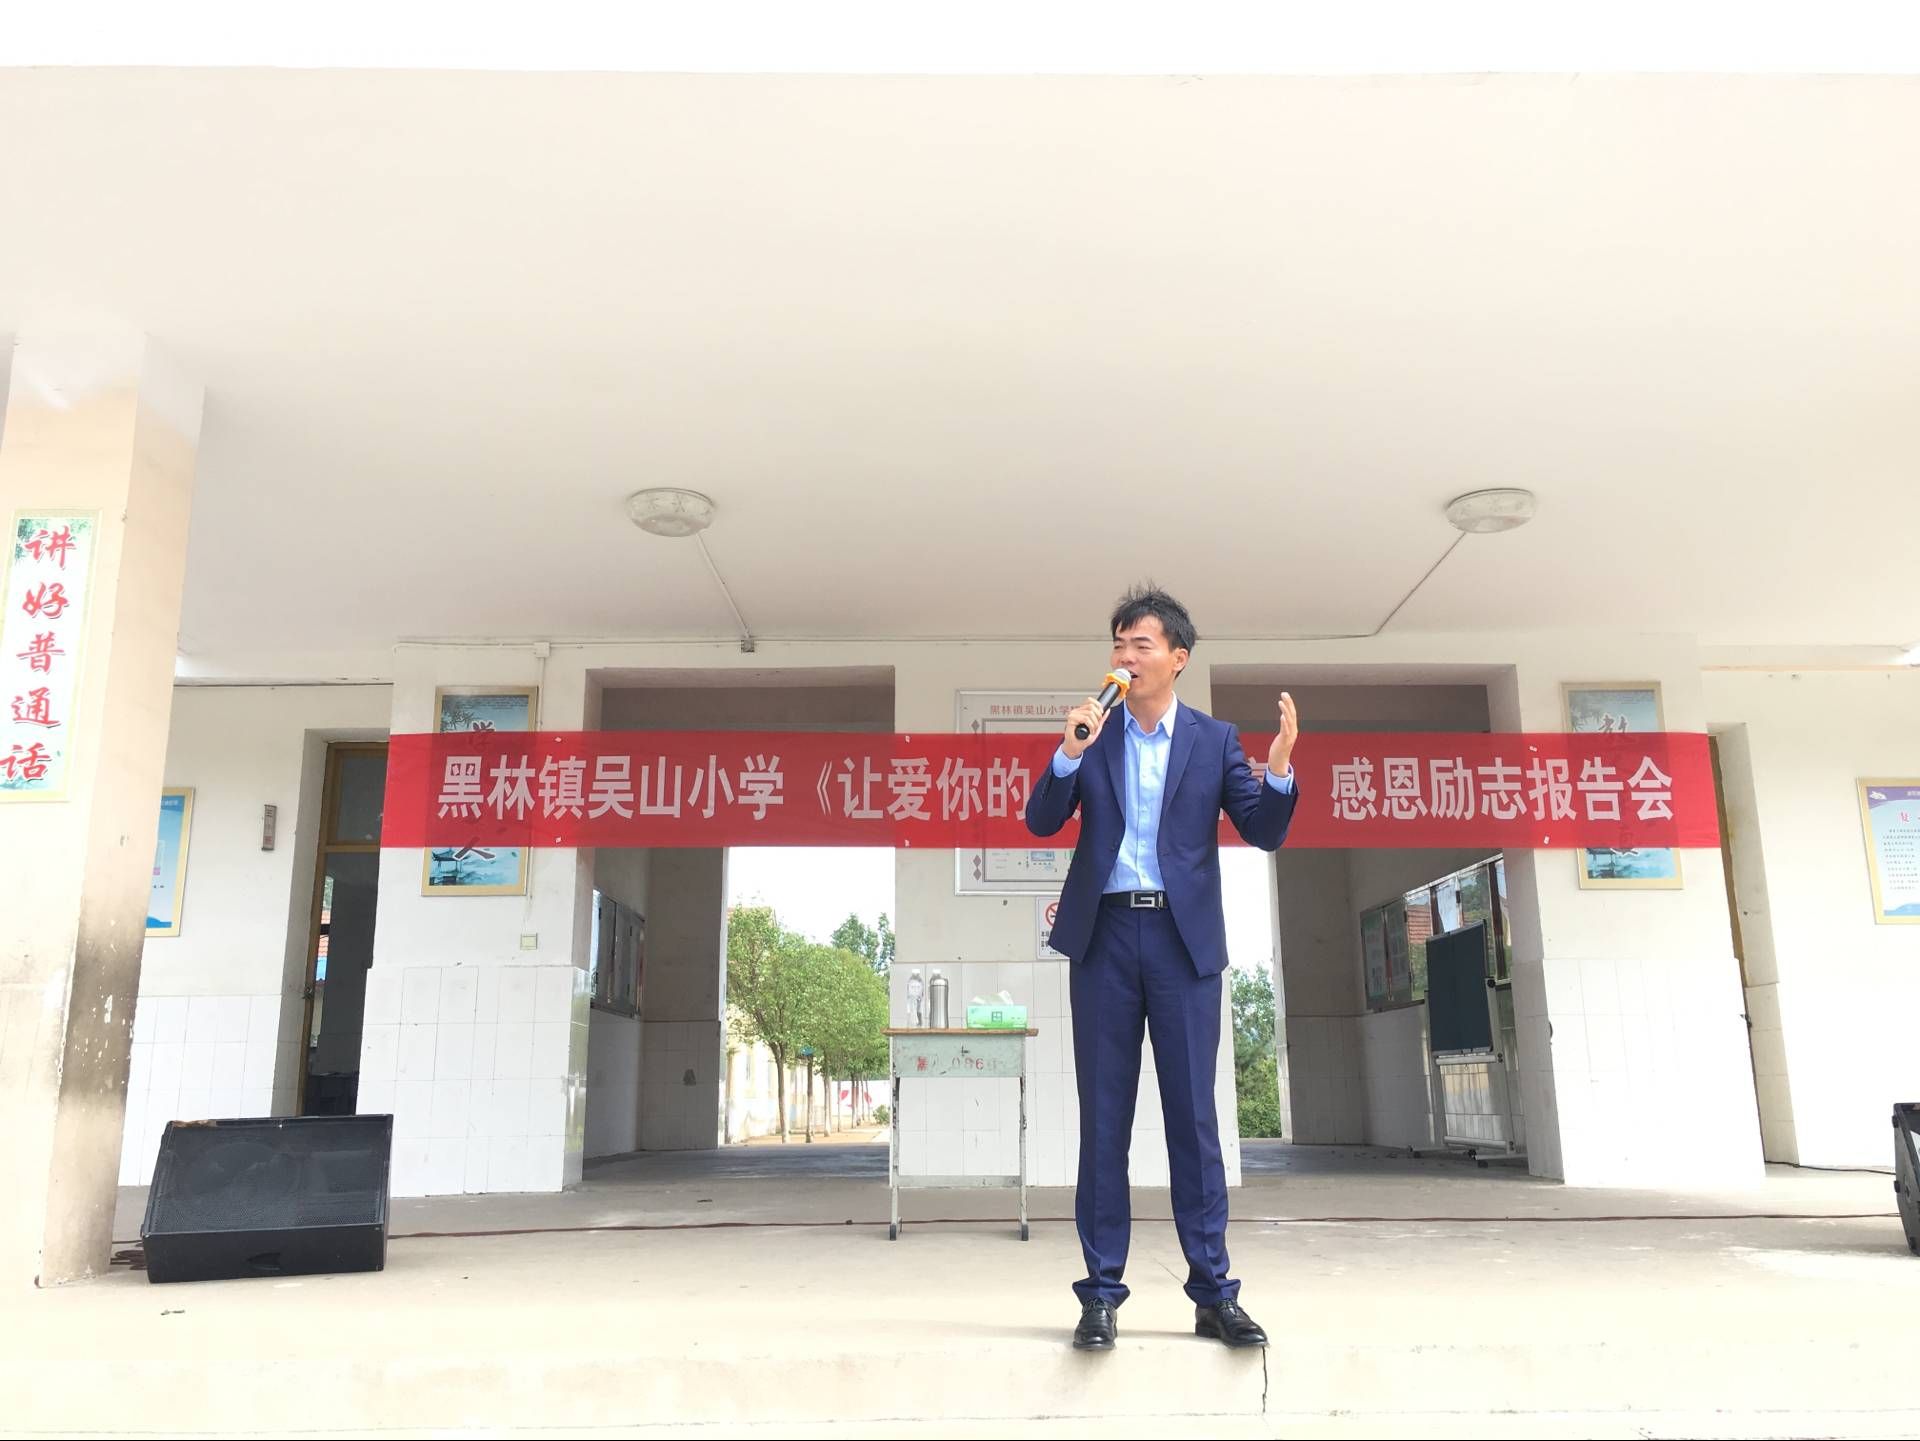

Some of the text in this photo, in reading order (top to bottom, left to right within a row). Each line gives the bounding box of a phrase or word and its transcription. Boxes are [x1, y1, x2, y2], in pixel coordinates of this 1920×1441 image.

[0, 525, 76, 781] 讲好普通话
[816, 755, 1080, 821] 《让爱你的
[1331, 755, 1674, 821] 感恩励志报告会
